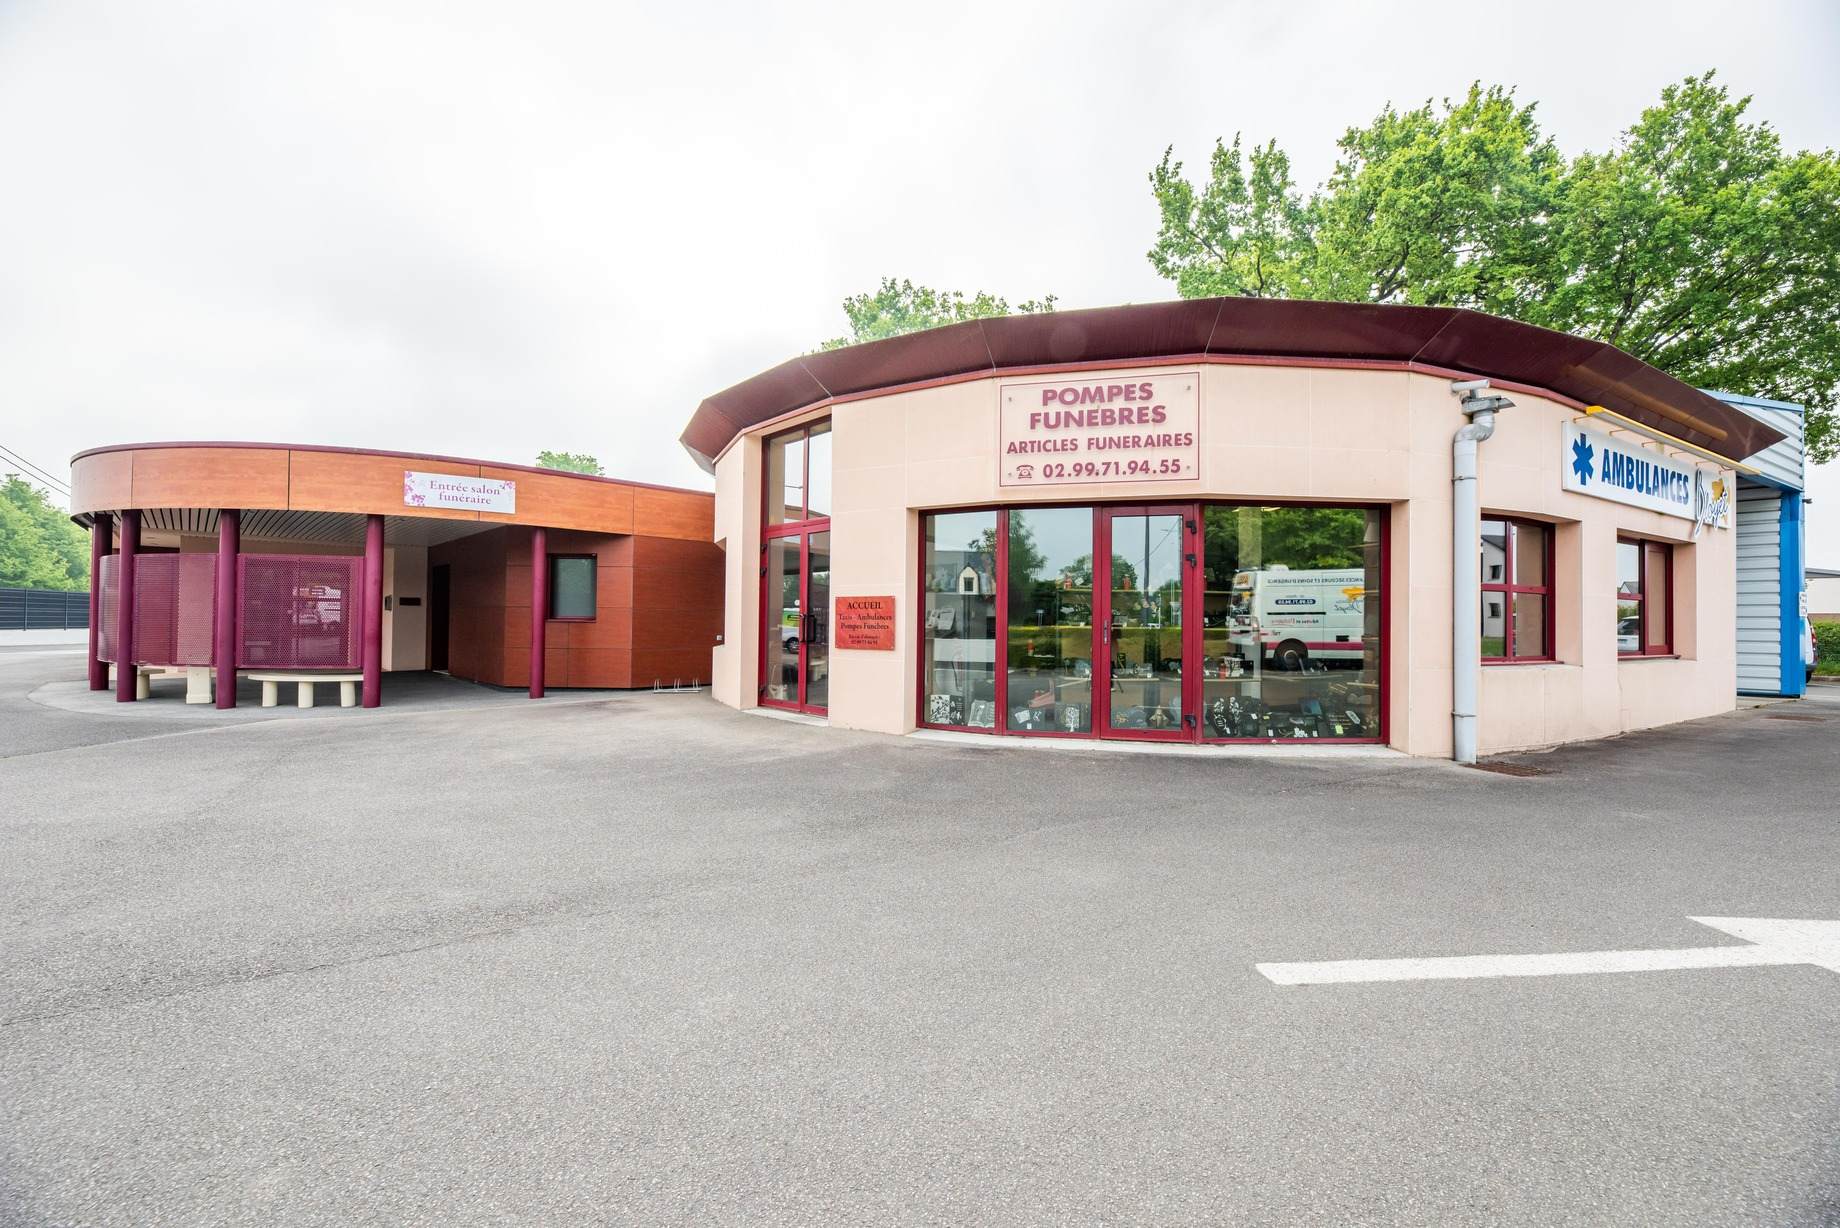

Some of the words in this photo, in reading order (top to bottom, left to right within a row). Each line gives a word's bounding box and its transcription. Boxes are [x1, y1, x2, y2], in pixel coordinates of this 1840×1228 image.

[1042, 382, 1154, 407] POMPES
[1029, 405, 1167, 430] FUNEBRES
[1006, 438, 1079, 455] ARTICLES
[1087, 432, 1193, 451] FUNERAIRES
[1042, 458, 1182, 479] 02.99.71.94.55
[1601, 448, 1689, 505] AMBULANCES
[429, 480, 468, 492] Entrée
[471, 484, 500, 496] salon
[439, 491, 492, 505] funéraire
[847, 601, 883, 610] ACCUEIL
